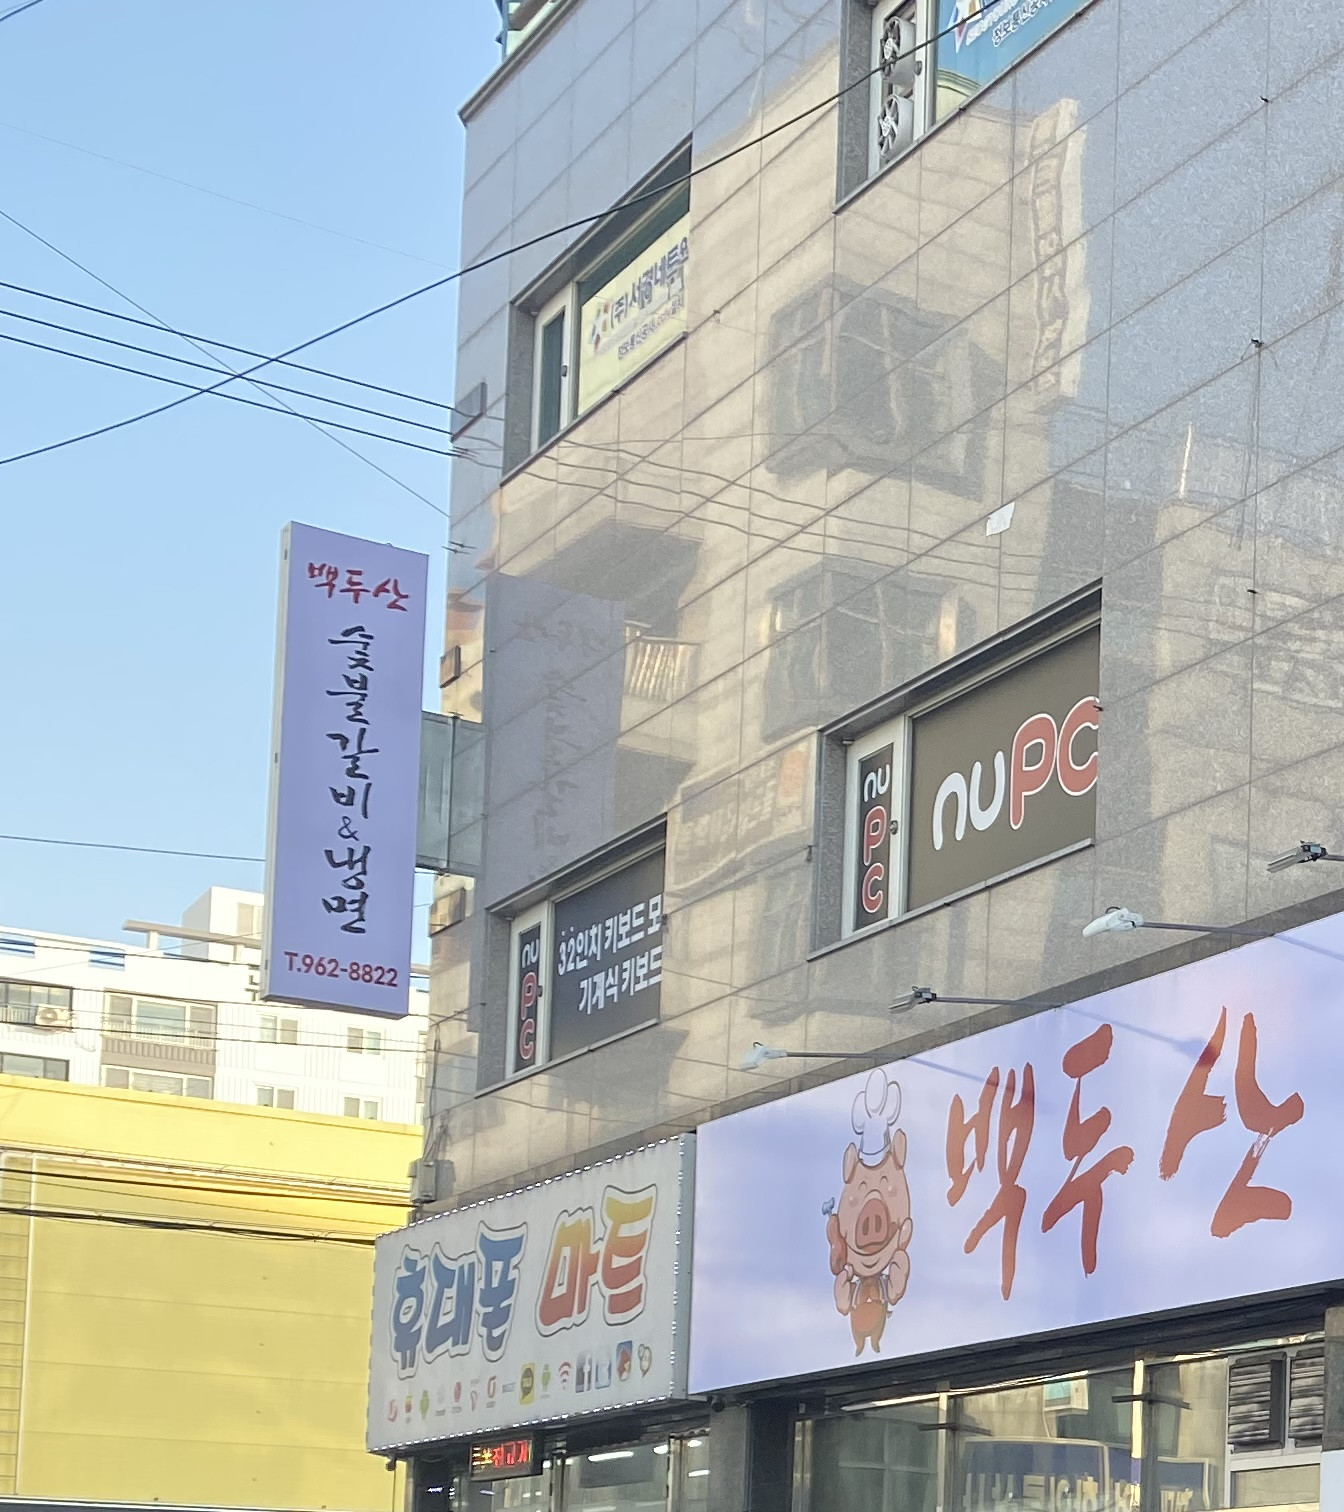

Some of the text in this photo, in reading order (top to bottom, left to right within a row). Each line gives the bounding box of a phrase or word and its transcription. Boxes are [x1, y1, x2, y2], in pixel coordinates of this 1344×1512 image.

[307, 561, 410, 613] 백두산
[604, 901, 646, 953] 키보드
[284, 951, 399, 988] T.962-8822
[945, 1005, 1305, 1301] 백두산
[537, 1189, 656, 1332] 마트
